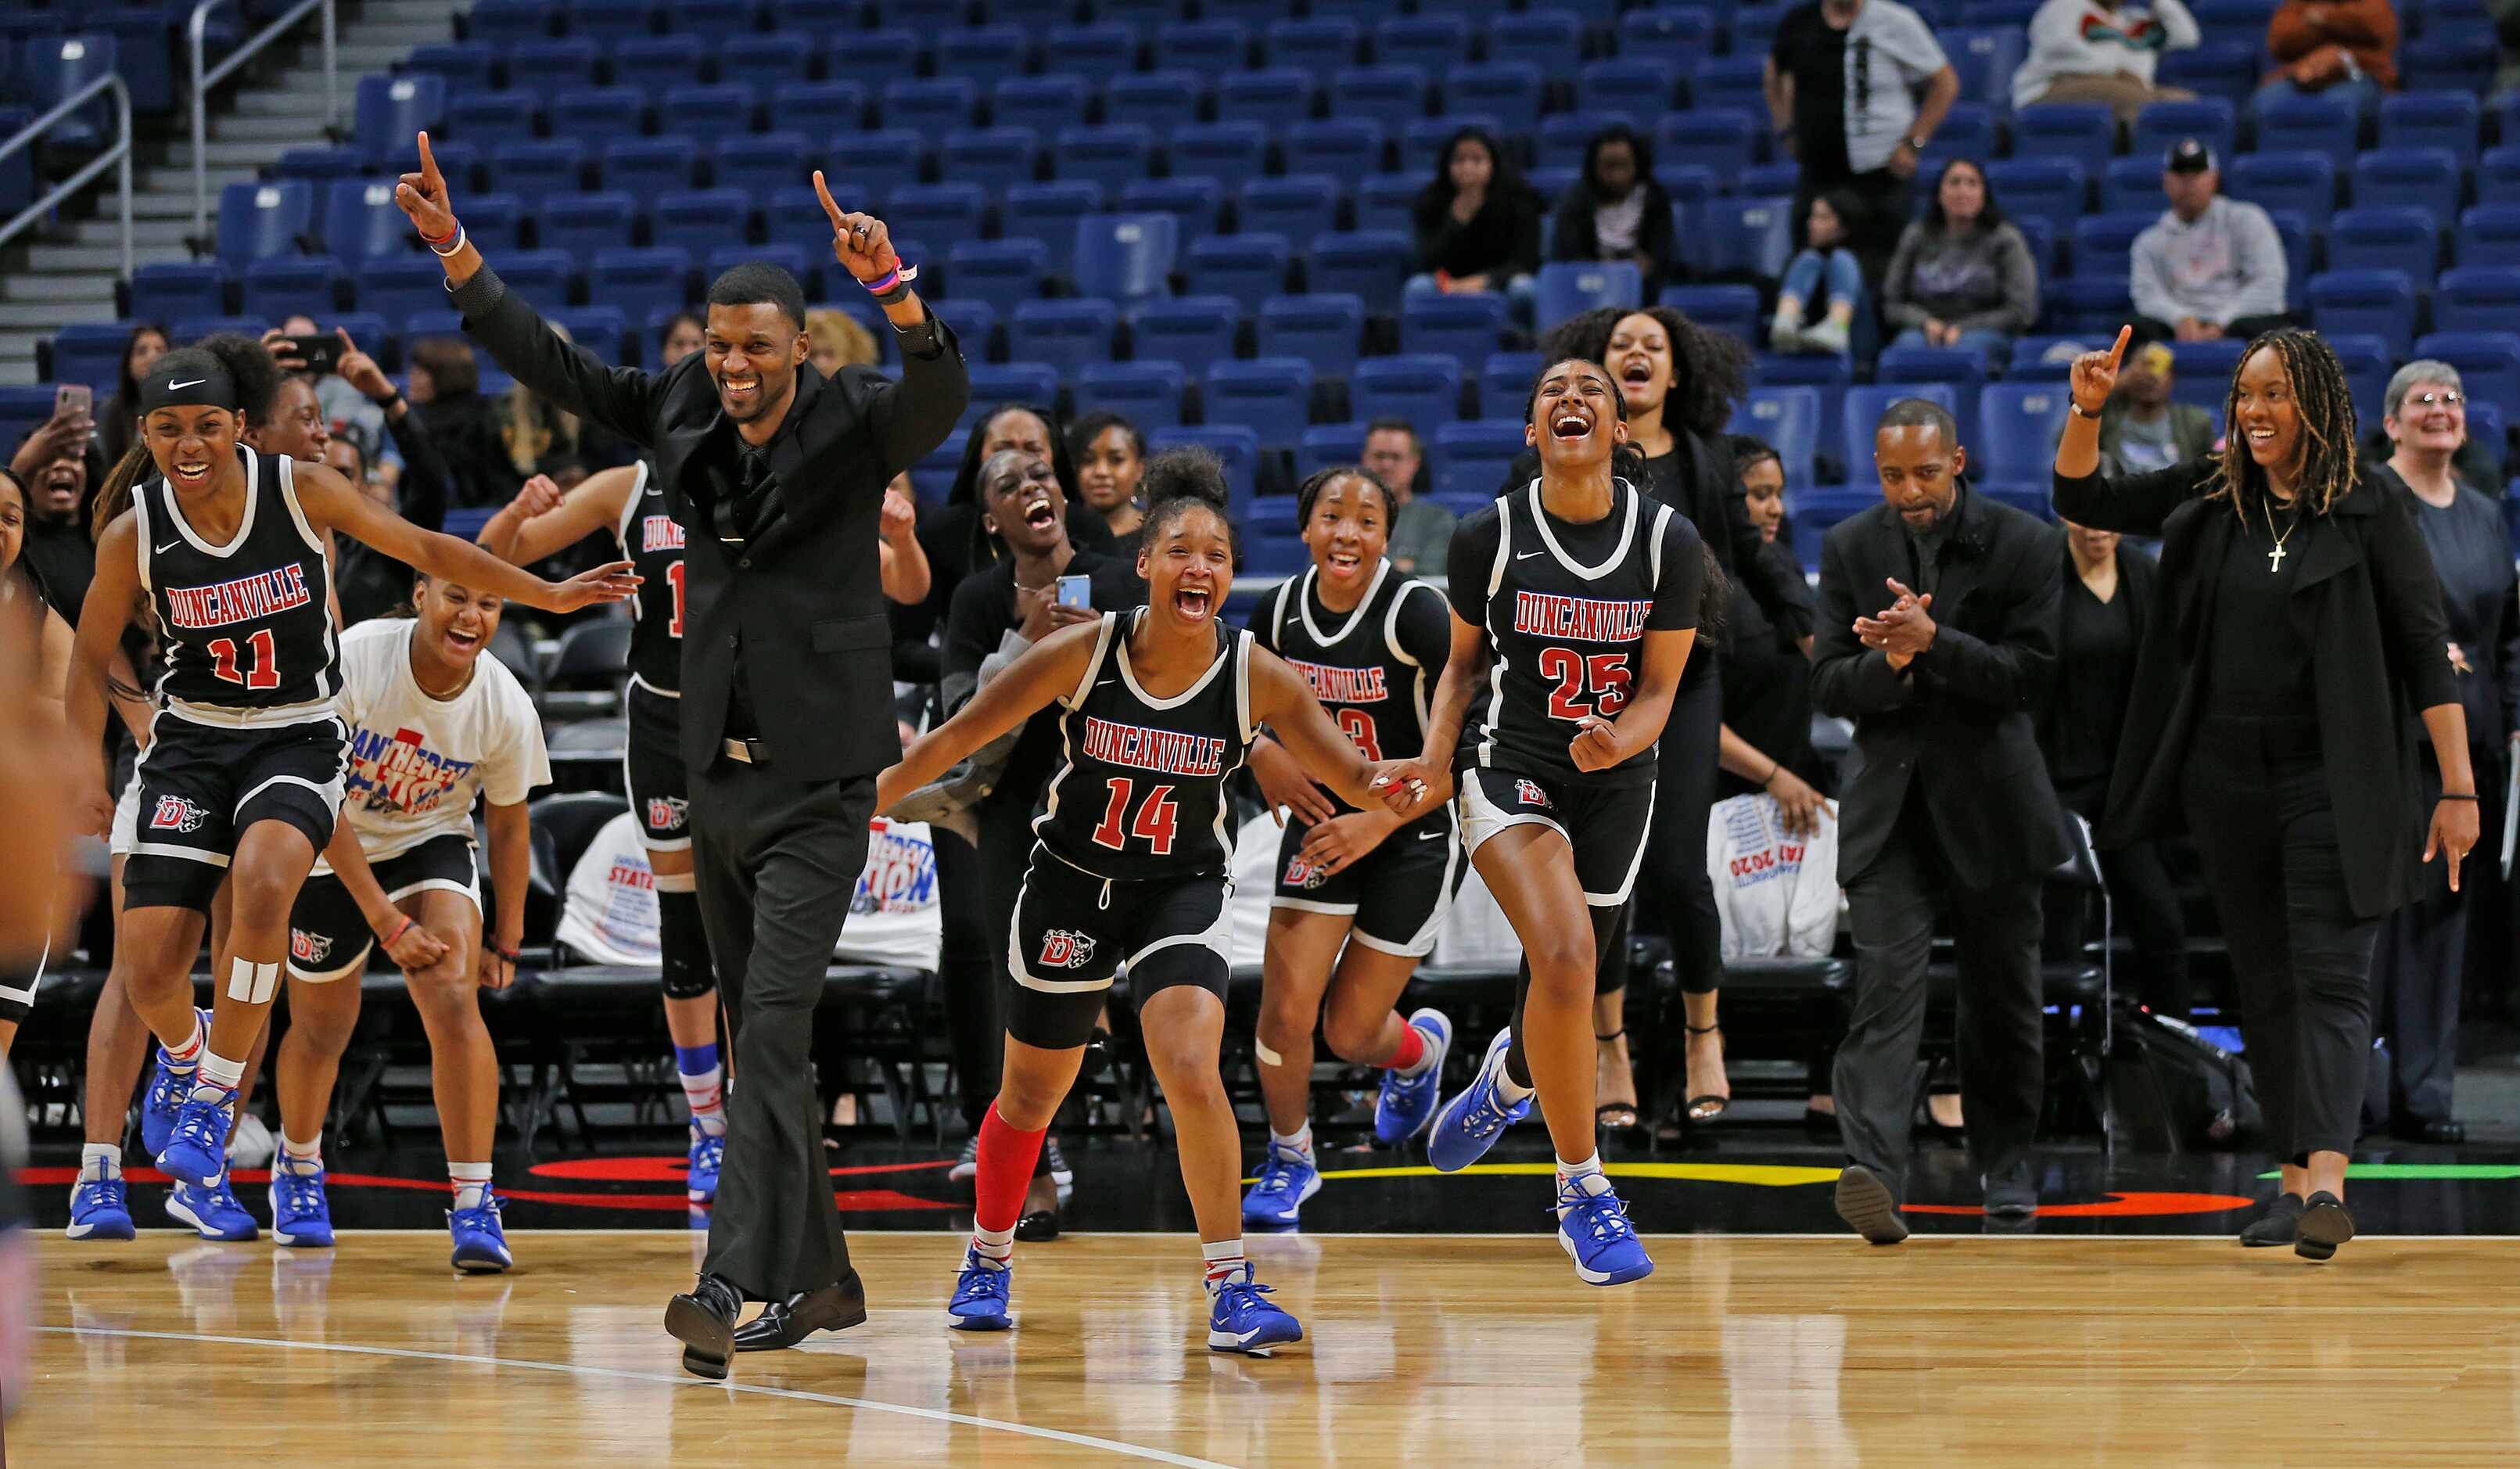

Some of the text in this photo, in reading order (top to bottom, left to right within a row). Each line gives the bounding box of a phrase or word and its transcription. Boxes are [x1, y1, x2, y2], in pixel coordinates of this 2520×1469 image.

[164, 562, 311, 629] DUNCANVILLE
[206, 629, 281, 690] 11
[1538, 647, 1632, 720] 25
[1082, 716, 1226, 777] DUNCANVILLE
[1322, 706, 1383, 762] 3
[1092, 778, 1179, 855] 14
[1730, 848, 1775, 877] 2020
